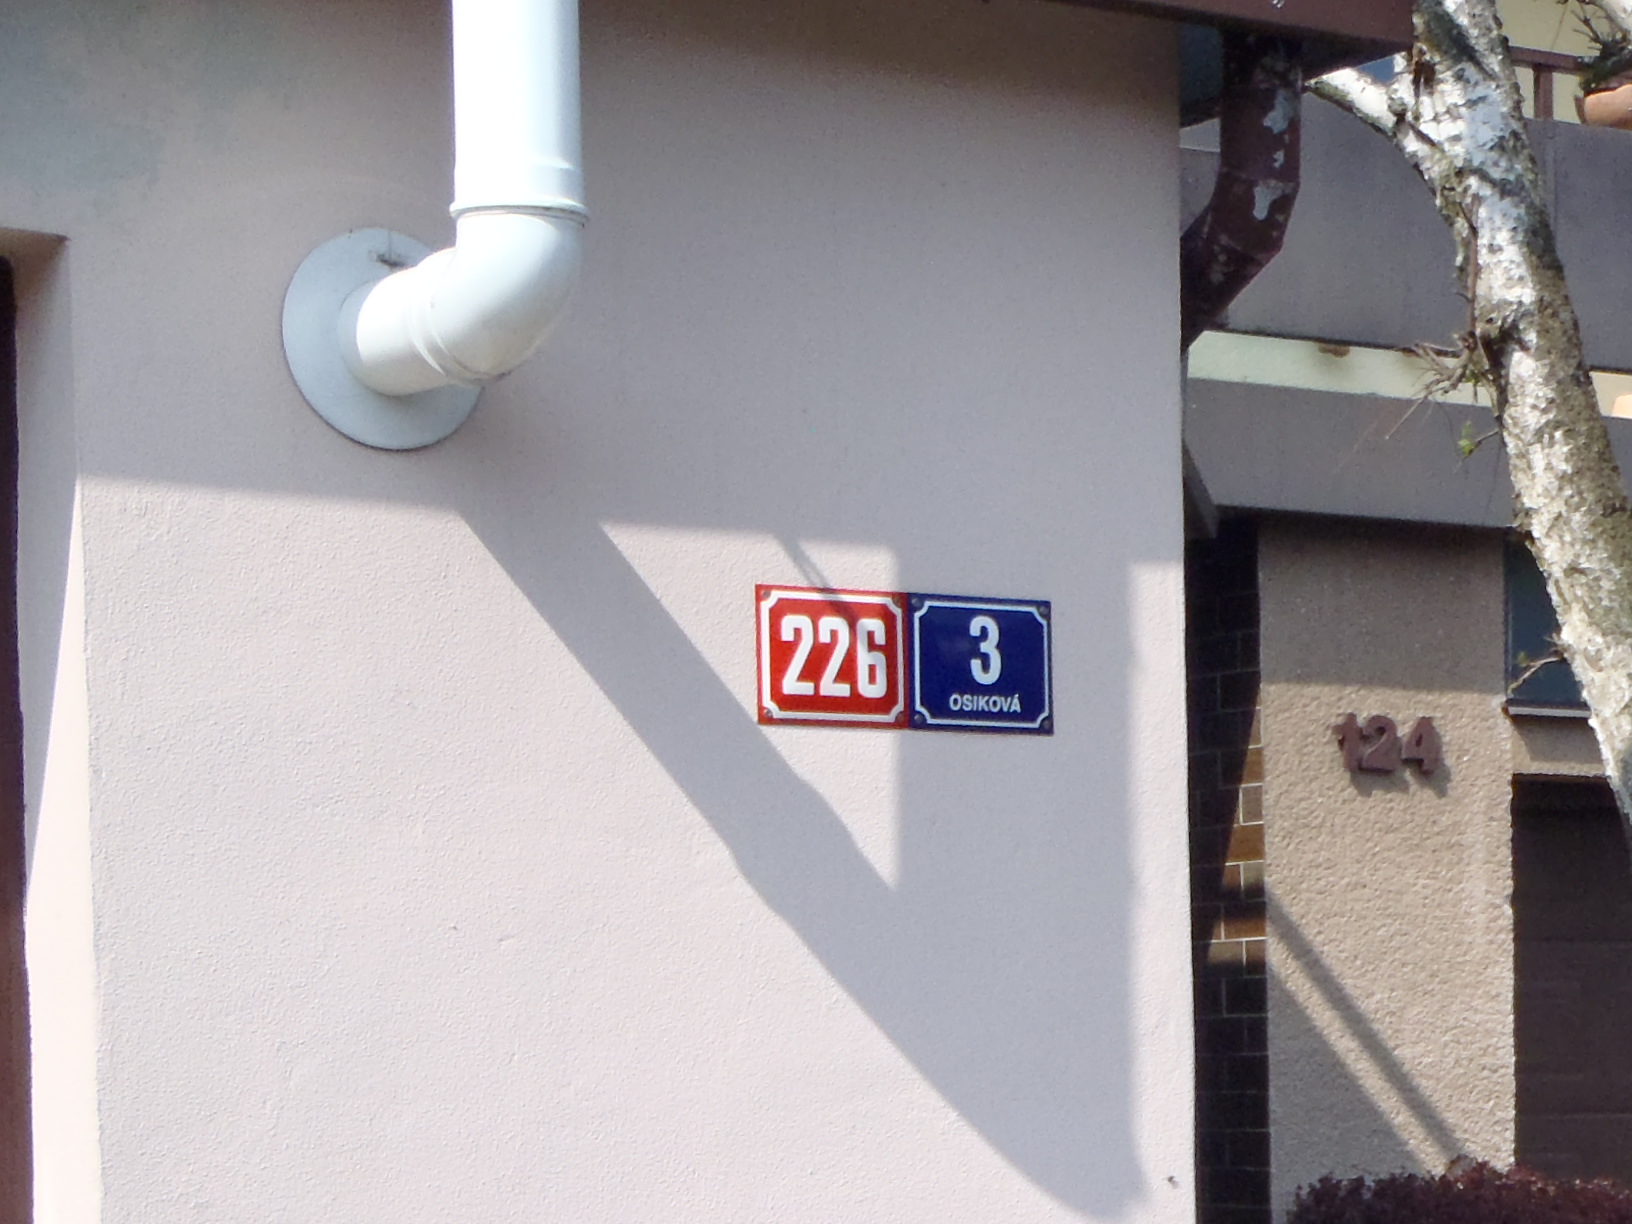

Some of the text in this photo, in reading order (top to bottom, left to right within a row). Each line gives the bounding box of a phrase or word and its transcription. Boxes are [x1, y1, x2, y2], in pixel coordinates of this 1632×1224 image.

[780, 614, 888, 699] 226
[969, 615, 1002, 686] 3
[949, 692, 1021, 714] OSIKOVÁ
[1331, 712, 1442, 776] 124
